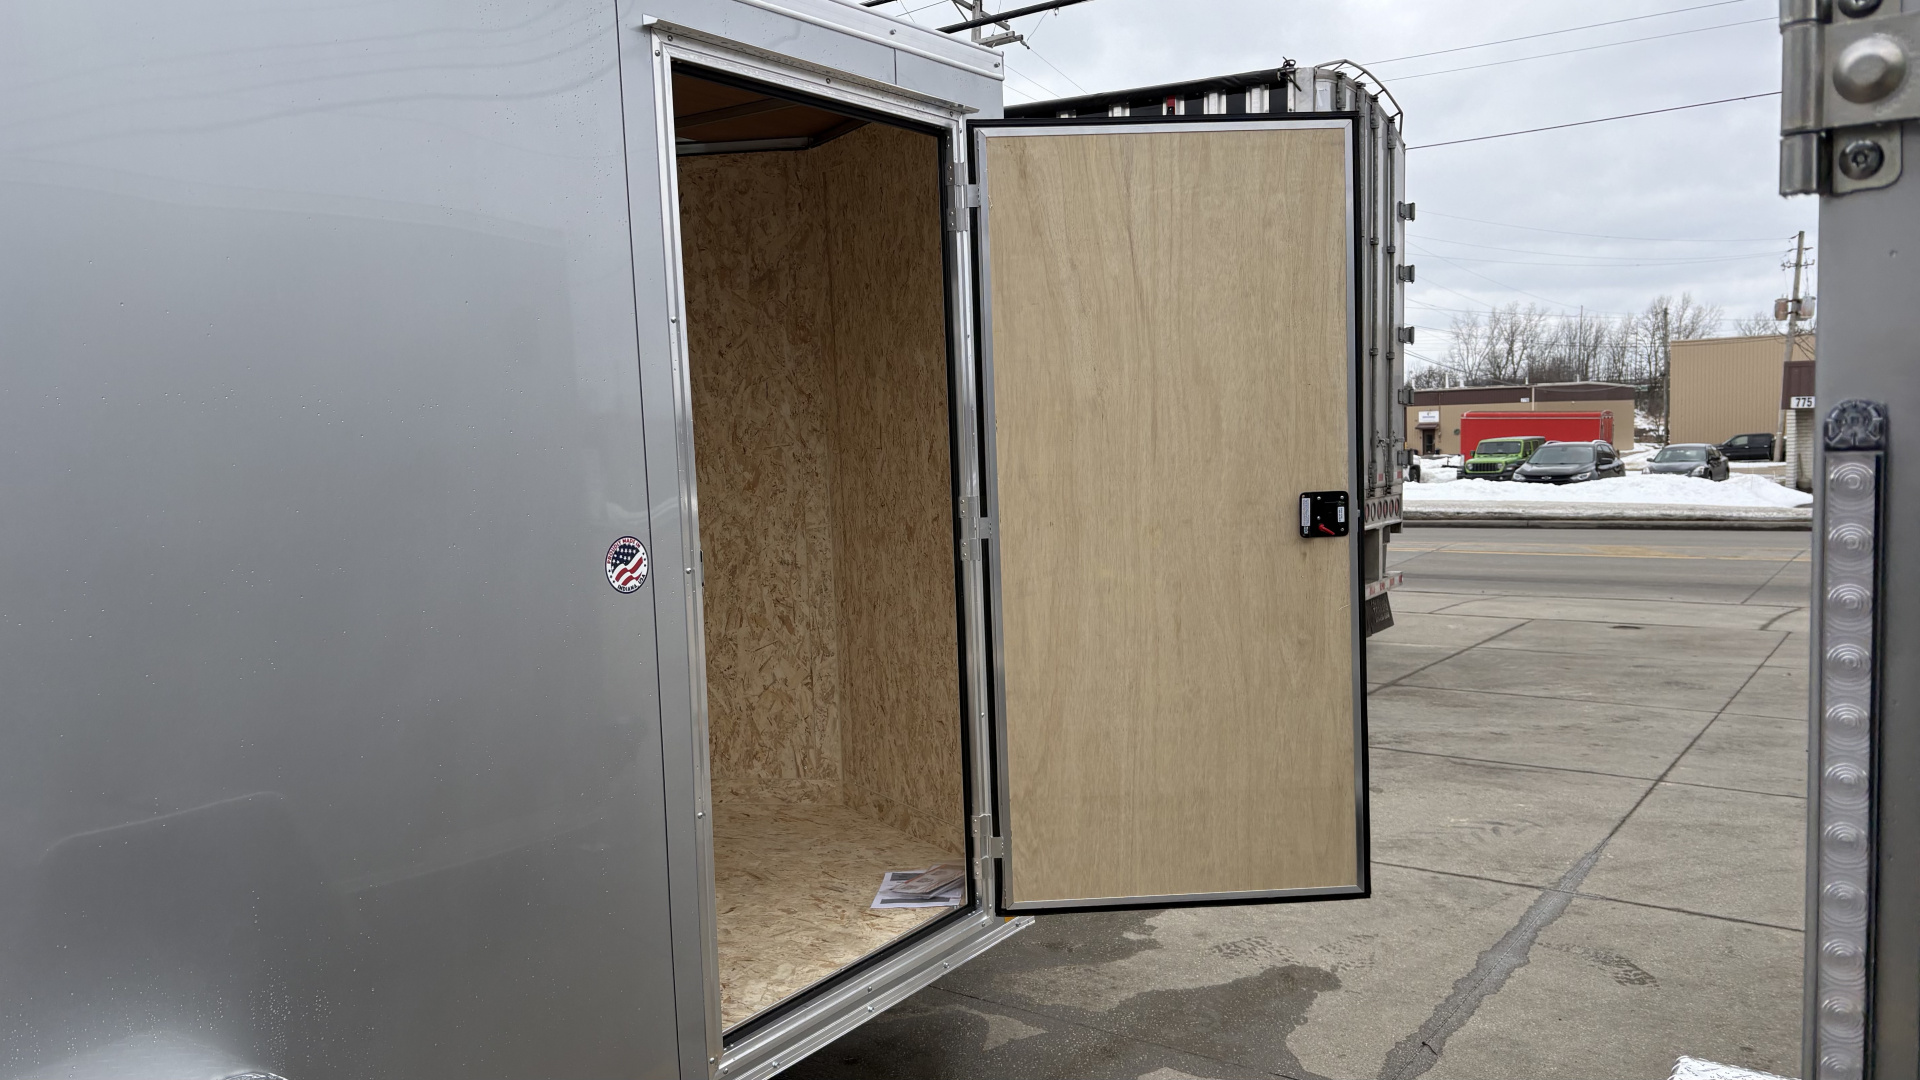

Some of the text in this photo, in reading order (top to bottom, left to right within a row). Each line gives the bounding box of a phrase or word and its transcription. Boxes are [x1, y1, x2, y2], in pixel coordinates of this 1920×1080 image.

[1795, 397, 1813, 408] 775
[607, 540, 621, 564] PROUDLY
[638, 574, 646, 584] USA
